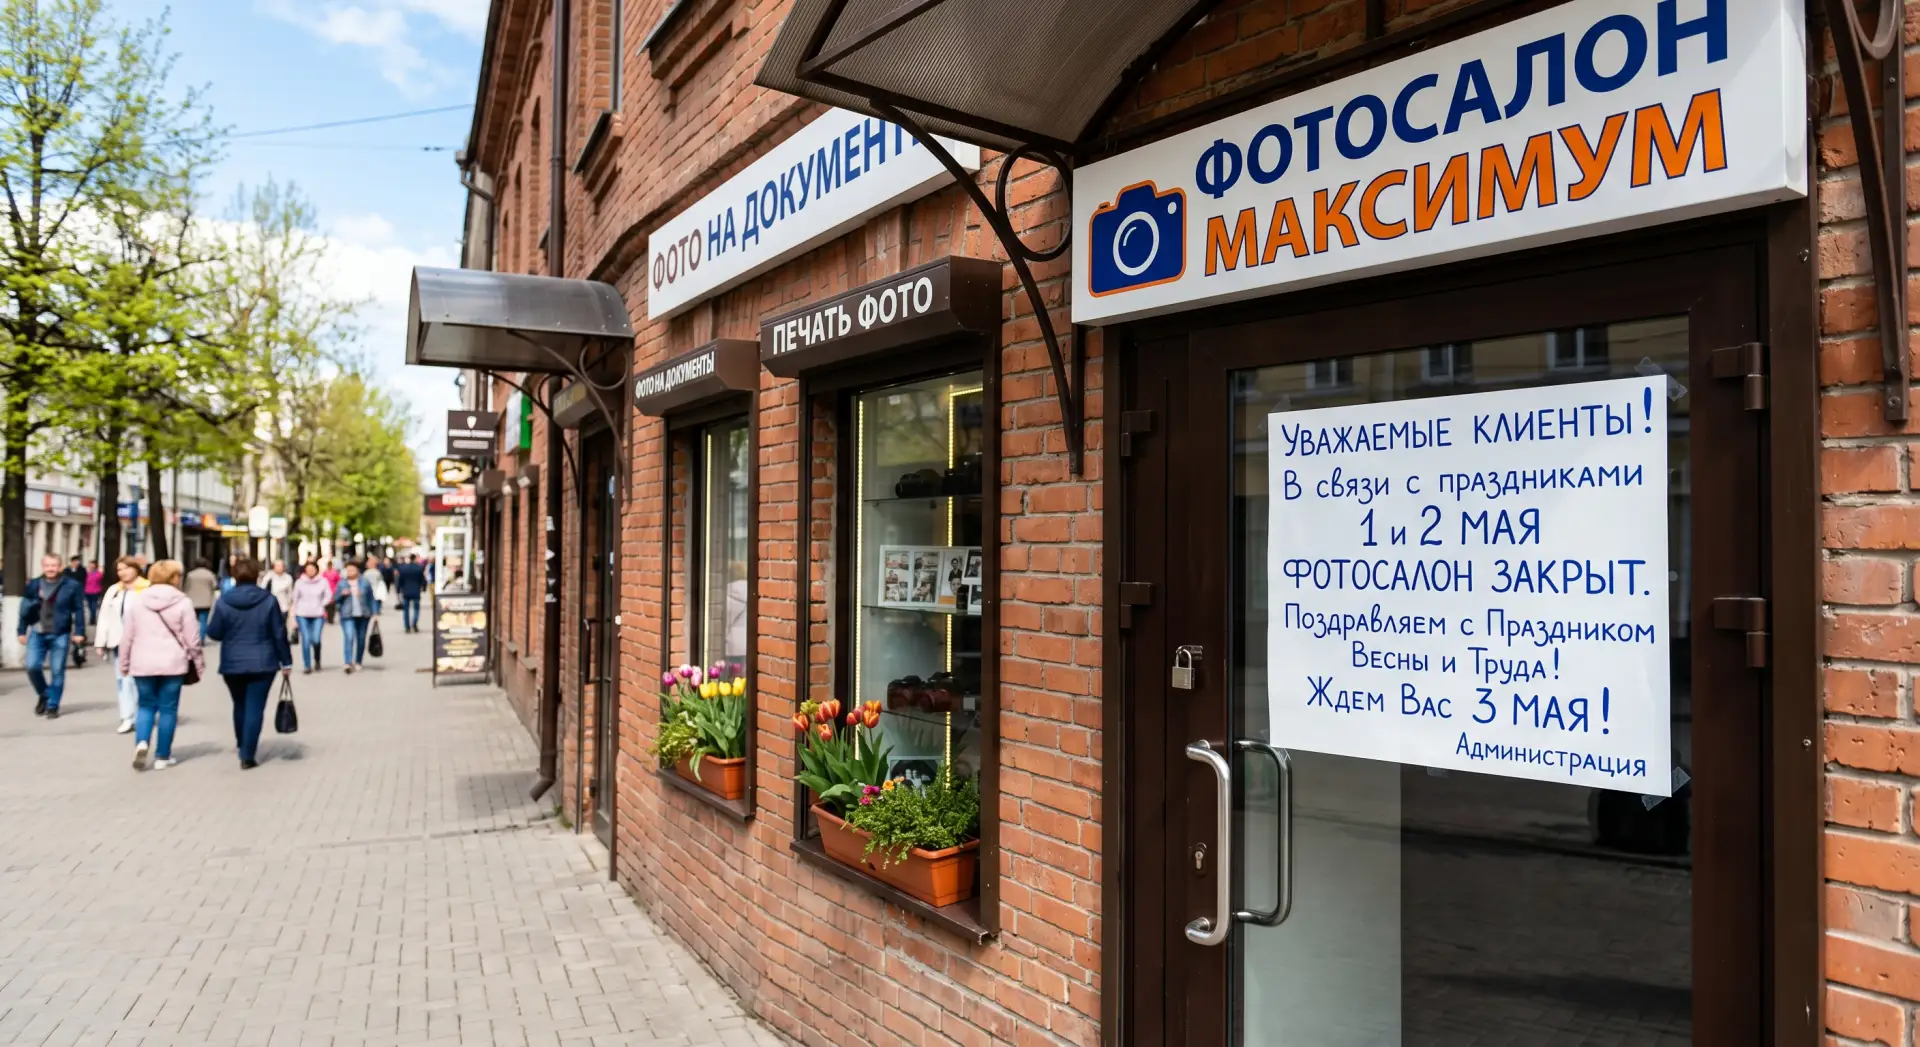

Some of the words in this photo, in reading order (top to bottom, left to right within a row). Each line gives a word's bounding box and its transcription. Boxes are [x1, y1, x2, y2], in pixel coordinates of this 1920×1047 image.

[1195, 0, 1729, 199] ФОТОСАЛОН
[652, 227, 702, 292] ФОТО
[707, 206, 737, 262] НА
[741, 117, 921, 252] ДОКУМЕН
[1204, 87, 1728, 278] МАКСИМУМ
[773, 304, 852, 356] ПЕЧАТЬ
[858, 276, 933, 330] ФОТО
[635, 375, 654, 399] ФОТО
[654, 371, 665, 393] НА
[665, 350, 715, 393] ДОКУМЕНТЫ
[1281, 417, 1452, 457] УВАЖАЕМЫЕ
[1473, 386, 1653, 445] КЛИЕНТЫ!
[1283, 469, 1303, 501] В
[1316, 466, 1390, 505] связи
[1406, 475, 1421, 496] с
[1439, 463, 1644, 502] праздниками
[1360, 508, 1378, 547] 1
[1390, 527, 1408, 546] и
[1419, 504, 1443, 547] 2
[1460, 507, 1541, 546] МАЯ
[1282, 558, 1473, 593] ФОТОСАЛОН
[1491, 558, 1651, 597] ЗАКРЫТ.
[1284, 602, 1447, 641] Поздравляем
[1459, 617, 1475, 637] с
[1486, 607, 1656, 648] Праздником
[1351, 640, 1430, 672] Весны
[1441, 655, 1457, 673] и
[1467, 647, 1560, 686] Труда!
[1306, 675, 1386, 714] Ждем
[1400, 682, 1453, 719] Вас
[1471, 687, 1497, 725] 3
[1512, 686, 1610, 736] МАЯ!
[1455, 731, 1647, 778] Администрация
